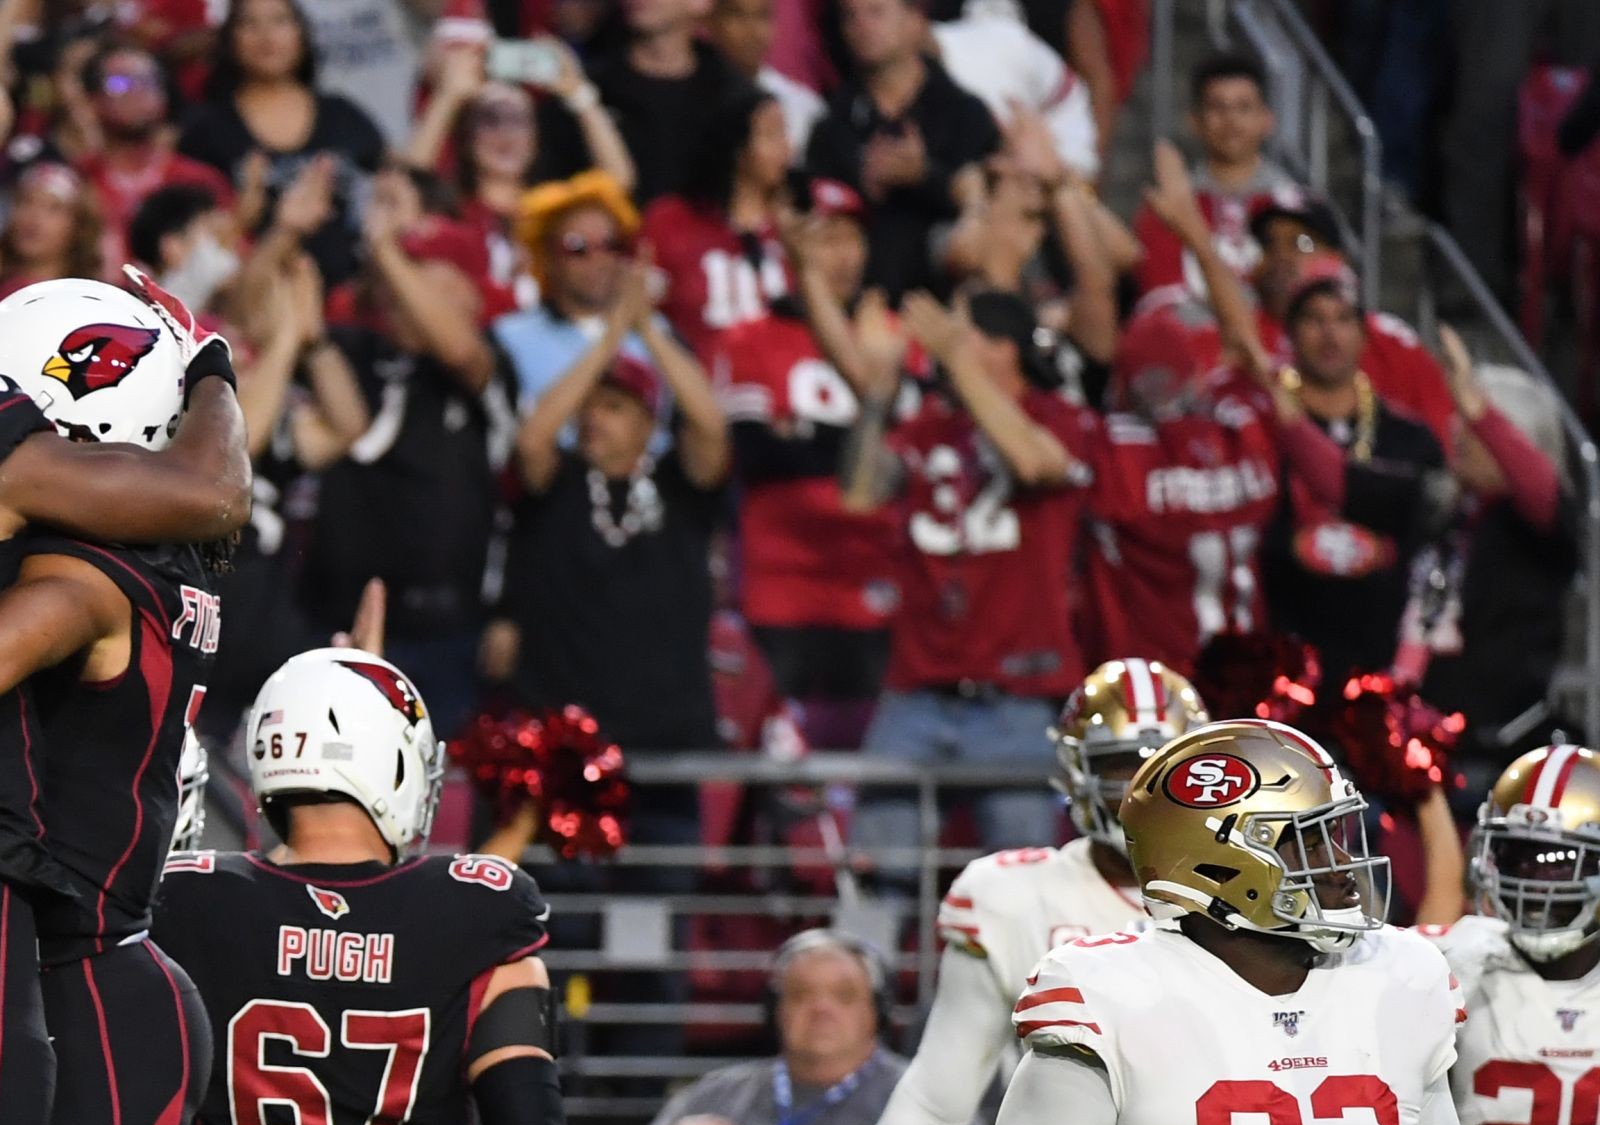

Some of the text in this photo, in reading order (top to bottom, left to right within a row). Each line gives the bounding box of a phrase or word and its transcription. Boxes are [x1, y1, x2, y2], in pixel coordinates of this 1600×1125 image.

[263, 768, 320, 779] CARDINALS
[277, 924, 394, 983] PUGH
[1267, 1056, 1328, 1072] 49ERS
